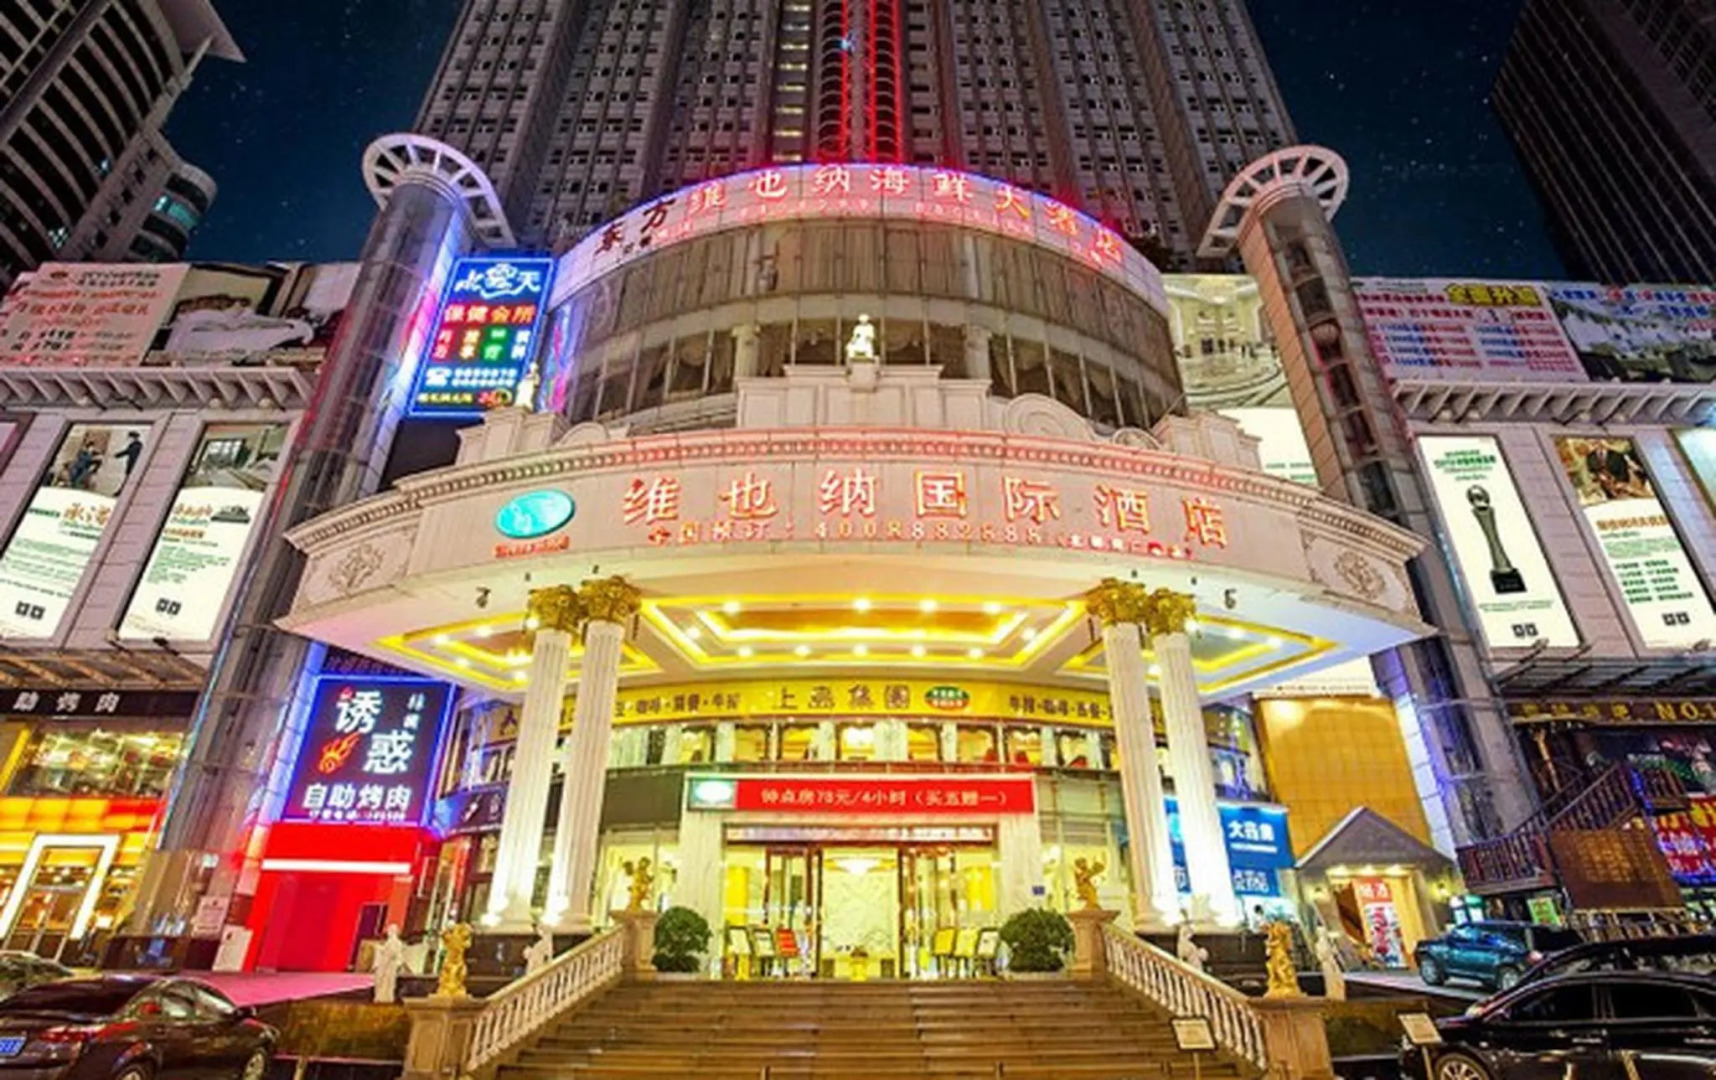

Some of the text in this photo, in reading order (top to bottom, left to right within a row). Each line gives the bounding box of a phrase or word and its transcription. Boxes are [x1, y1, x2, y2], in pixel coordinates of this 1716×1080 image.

[622, 468, 1231, 548] 维也纳国际酒店
[14, 692, 119, 713] 助烤肉
[302, 783, 412, 812] 自助烤肉
